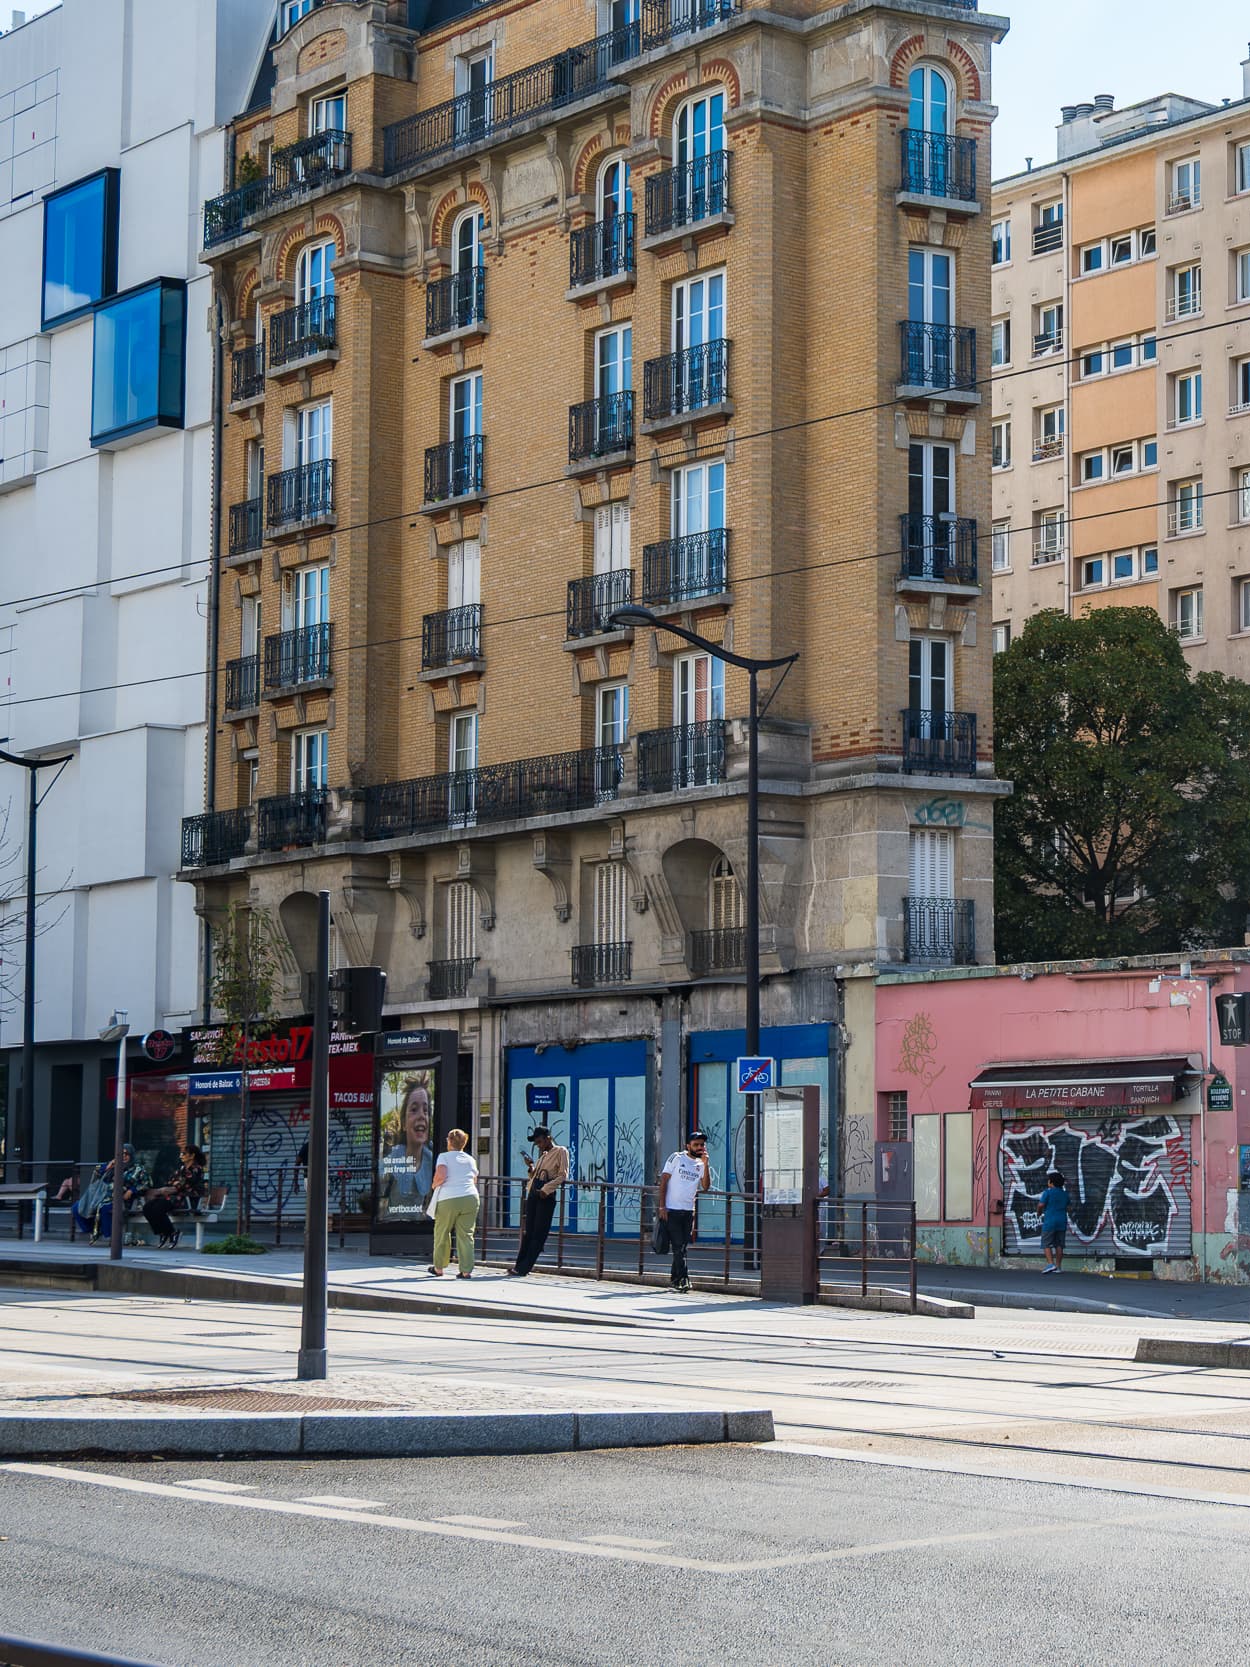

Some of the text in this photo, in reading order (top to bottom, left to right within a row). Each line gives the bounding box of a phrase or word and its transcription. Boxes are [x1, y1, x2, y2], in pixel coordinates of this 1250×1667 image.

[1223, 1028, 1242, 1040] STOP
[328, 1042, 359, 1054] TEX-MEX
[195, 1079, 233, 1089] Honoré de Balzac
[1132, 1084, 1159, 1093] TORTILLA
[333, 1092, 358, 1103] TACOS
[984, 1089, 1002, 1097] PANINI
[1025, 1086, 1106, 1099] LA PETITE CABANE
[1130, 1096, 1160, 1104] SANDWICH
